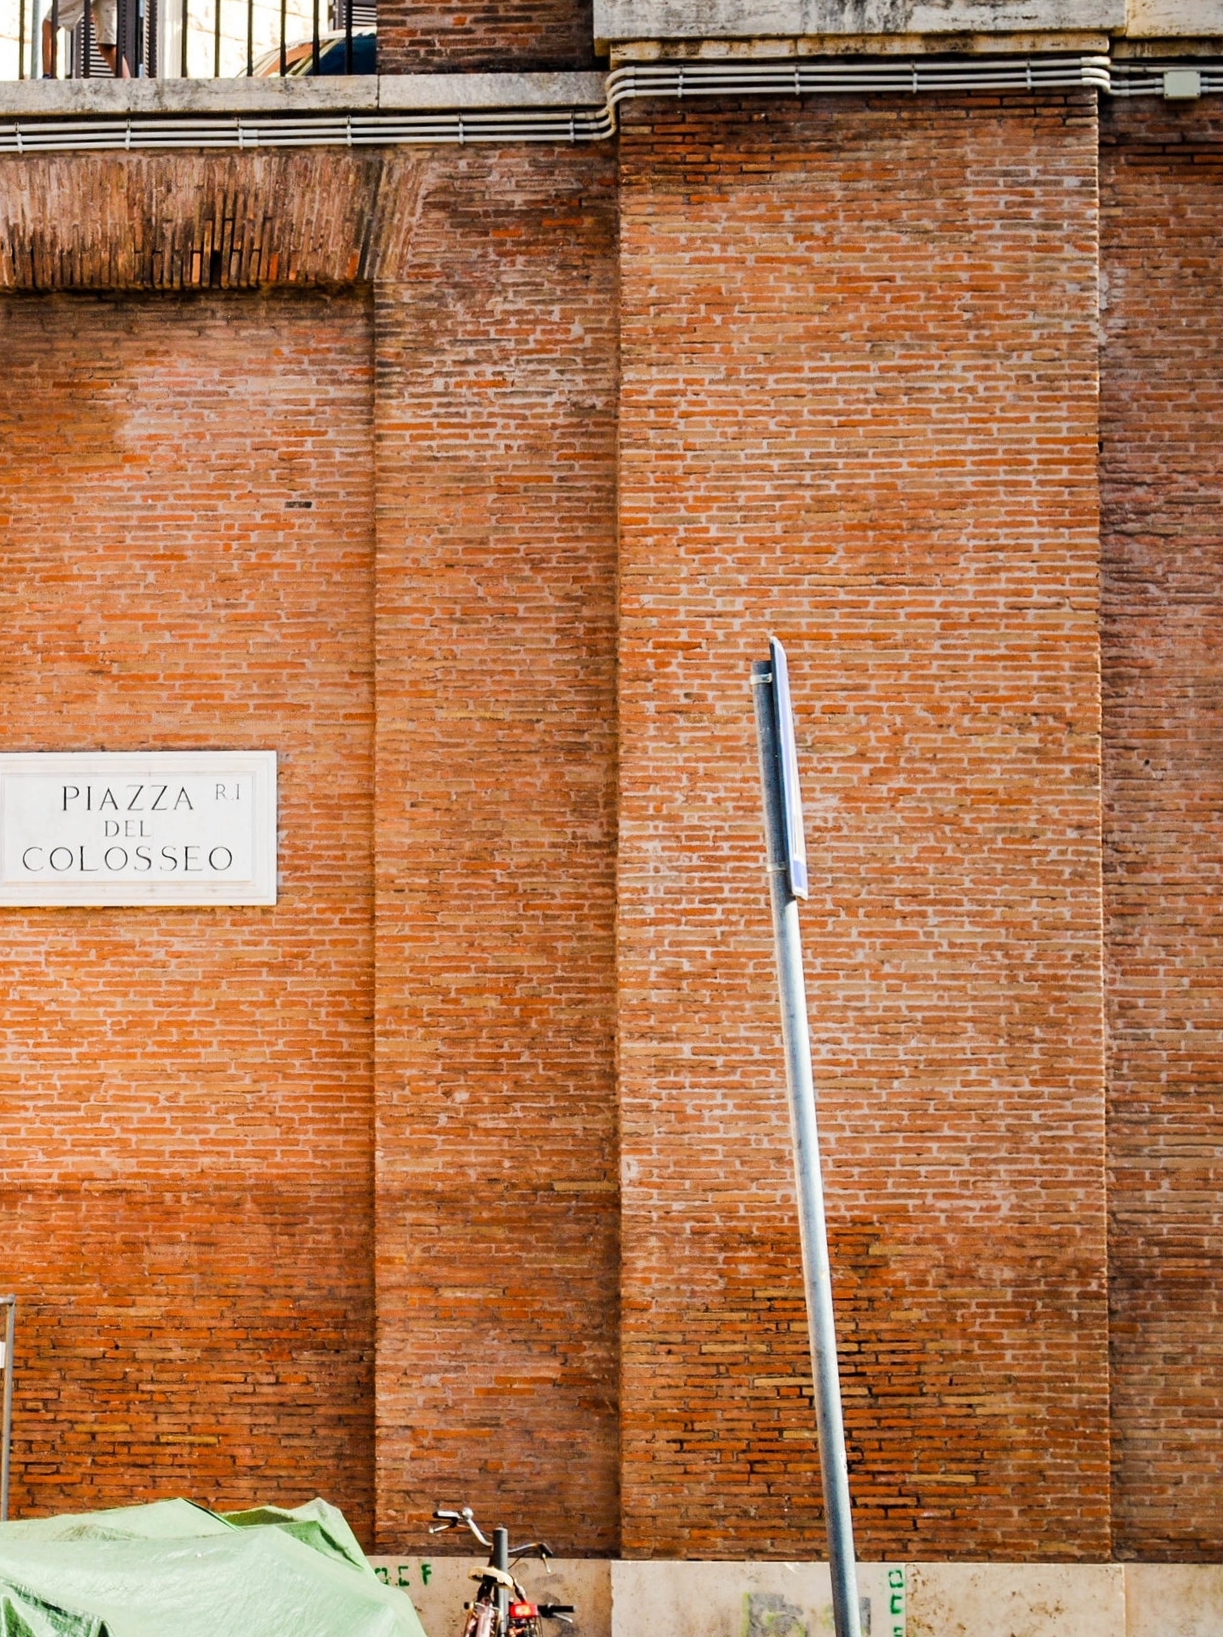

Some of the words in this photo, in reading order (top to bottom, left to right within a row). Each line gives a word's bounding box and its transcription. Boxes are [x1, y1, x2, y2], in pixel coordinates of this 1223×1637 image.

[61, 785, 194, 812] PIAZZA
[104, 820, 151, 838] DEL
[22, 846, 233, 872] COLOSSEO
